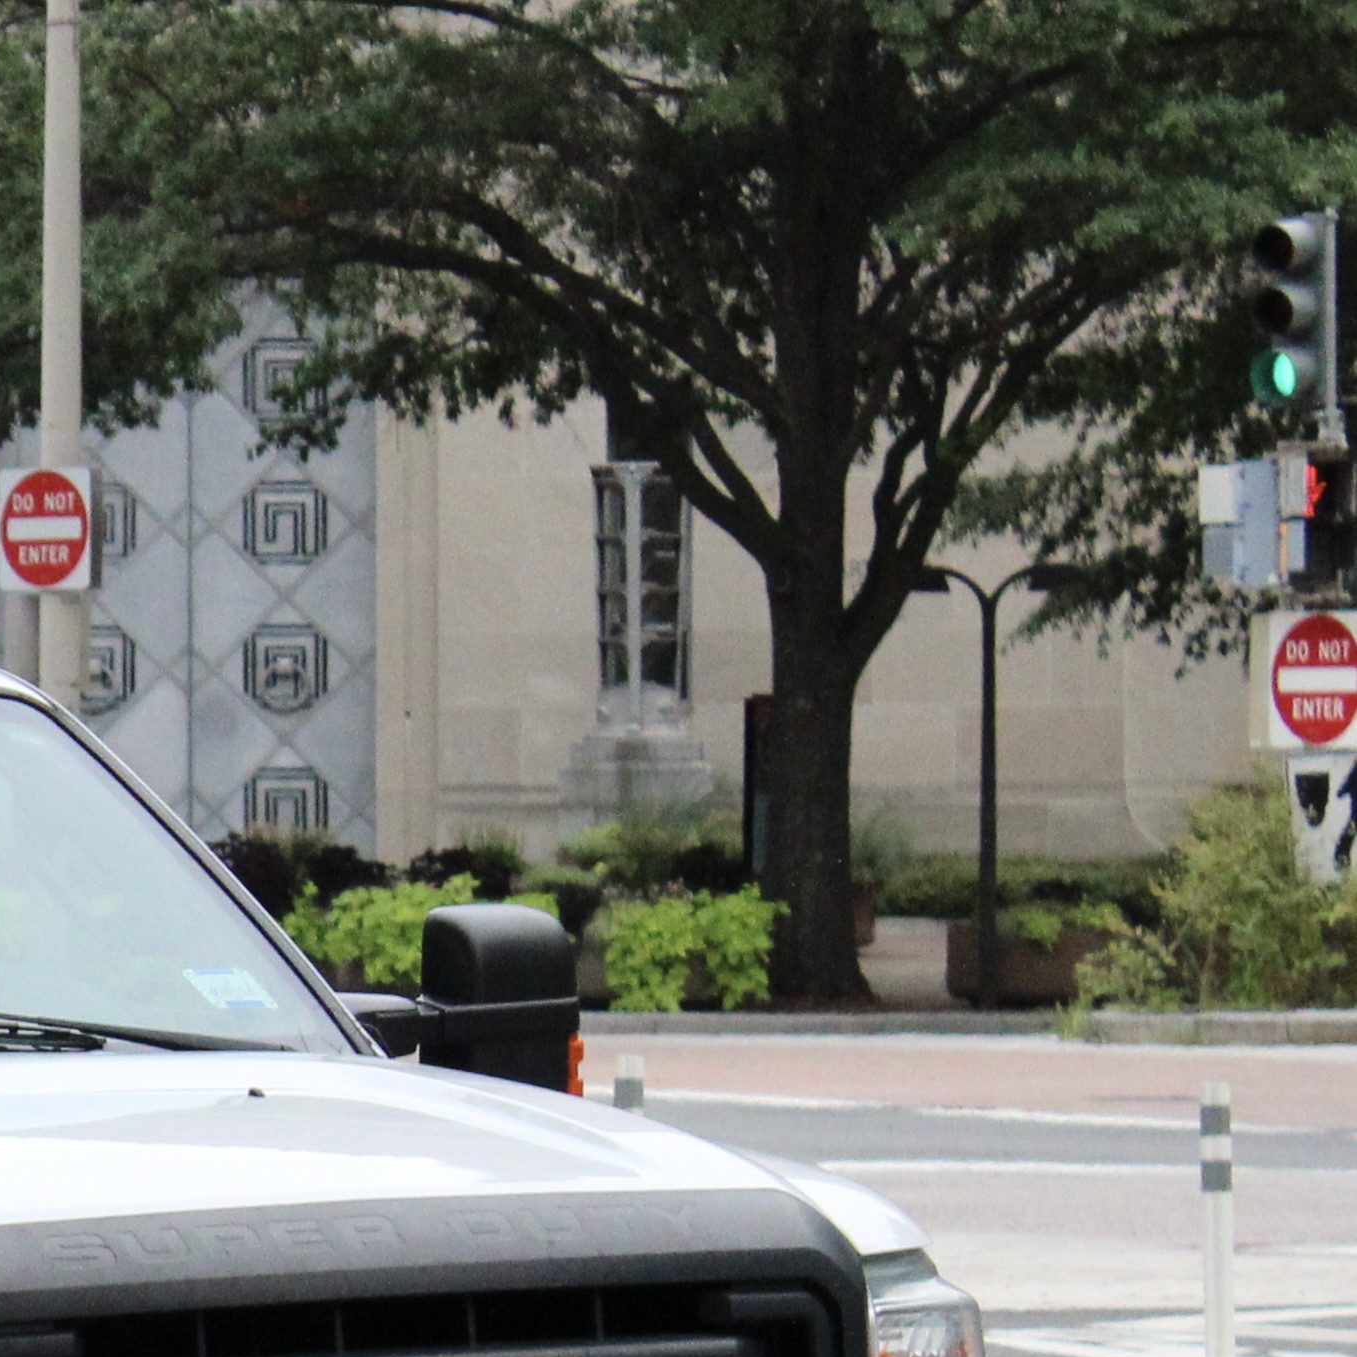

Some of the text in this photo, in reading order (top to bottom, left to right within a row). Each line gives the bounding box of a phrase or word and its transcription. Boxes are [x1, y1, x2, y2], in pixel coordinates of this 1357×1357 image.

[12, 491, 75, 512] DO NOT
[19, 545, 69, 565] ENTER
[1286, 640, 1350, 663] DO NOT
[1292, 697, 1344, 720] ENTER
[42, 1214, 408, 1272] SUPER
